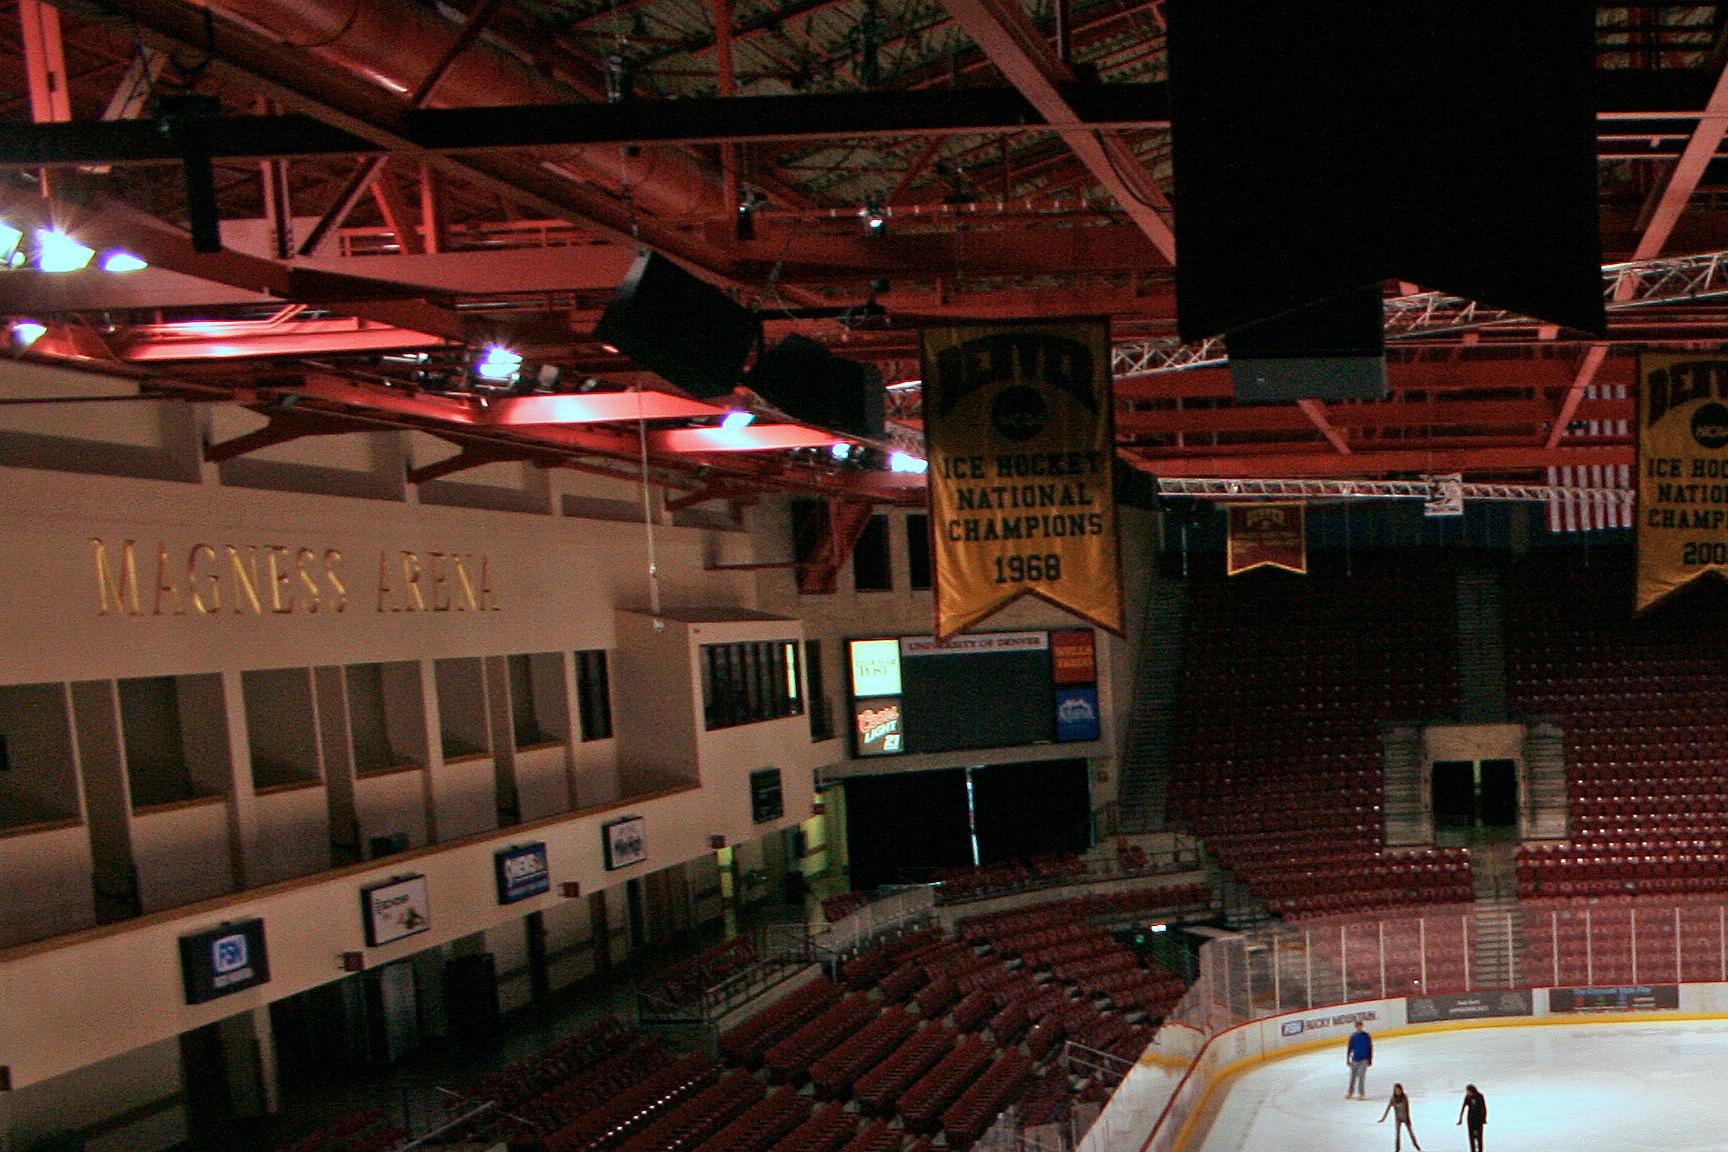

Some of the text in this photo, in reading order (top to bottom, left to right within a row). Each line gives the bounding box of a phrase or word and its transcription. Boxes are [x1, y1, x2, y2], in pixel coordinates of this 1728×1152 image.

[945, 450, 1102, 479] ICE HOCKEY
[1649, 458, 1681, 479] ICE
[957, 482, 1093, 510] NATIONAL
[949, 512, 1104, 541] CHAMPIONS
[88, 536, 502, 617] MAGNESS ARENA
[994, 553, 1062, 584] 1968
